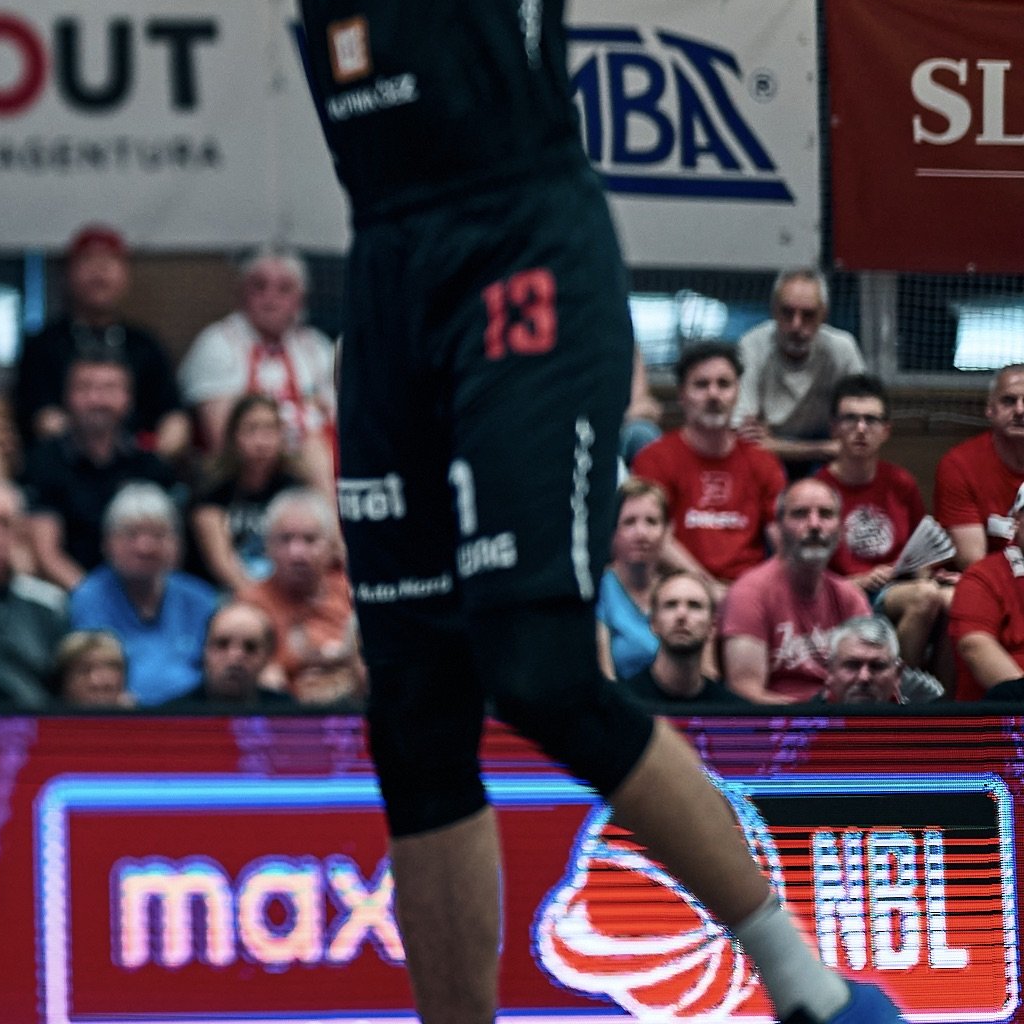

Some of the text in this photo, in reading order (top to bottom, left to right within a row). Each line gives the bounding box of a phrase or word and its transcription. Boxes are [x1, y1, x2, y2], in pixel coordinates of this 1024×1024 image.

[481, 267, 558, 360] 13
[111, 851, 406, 971] max
[810, 827, 970, 970] NBL
